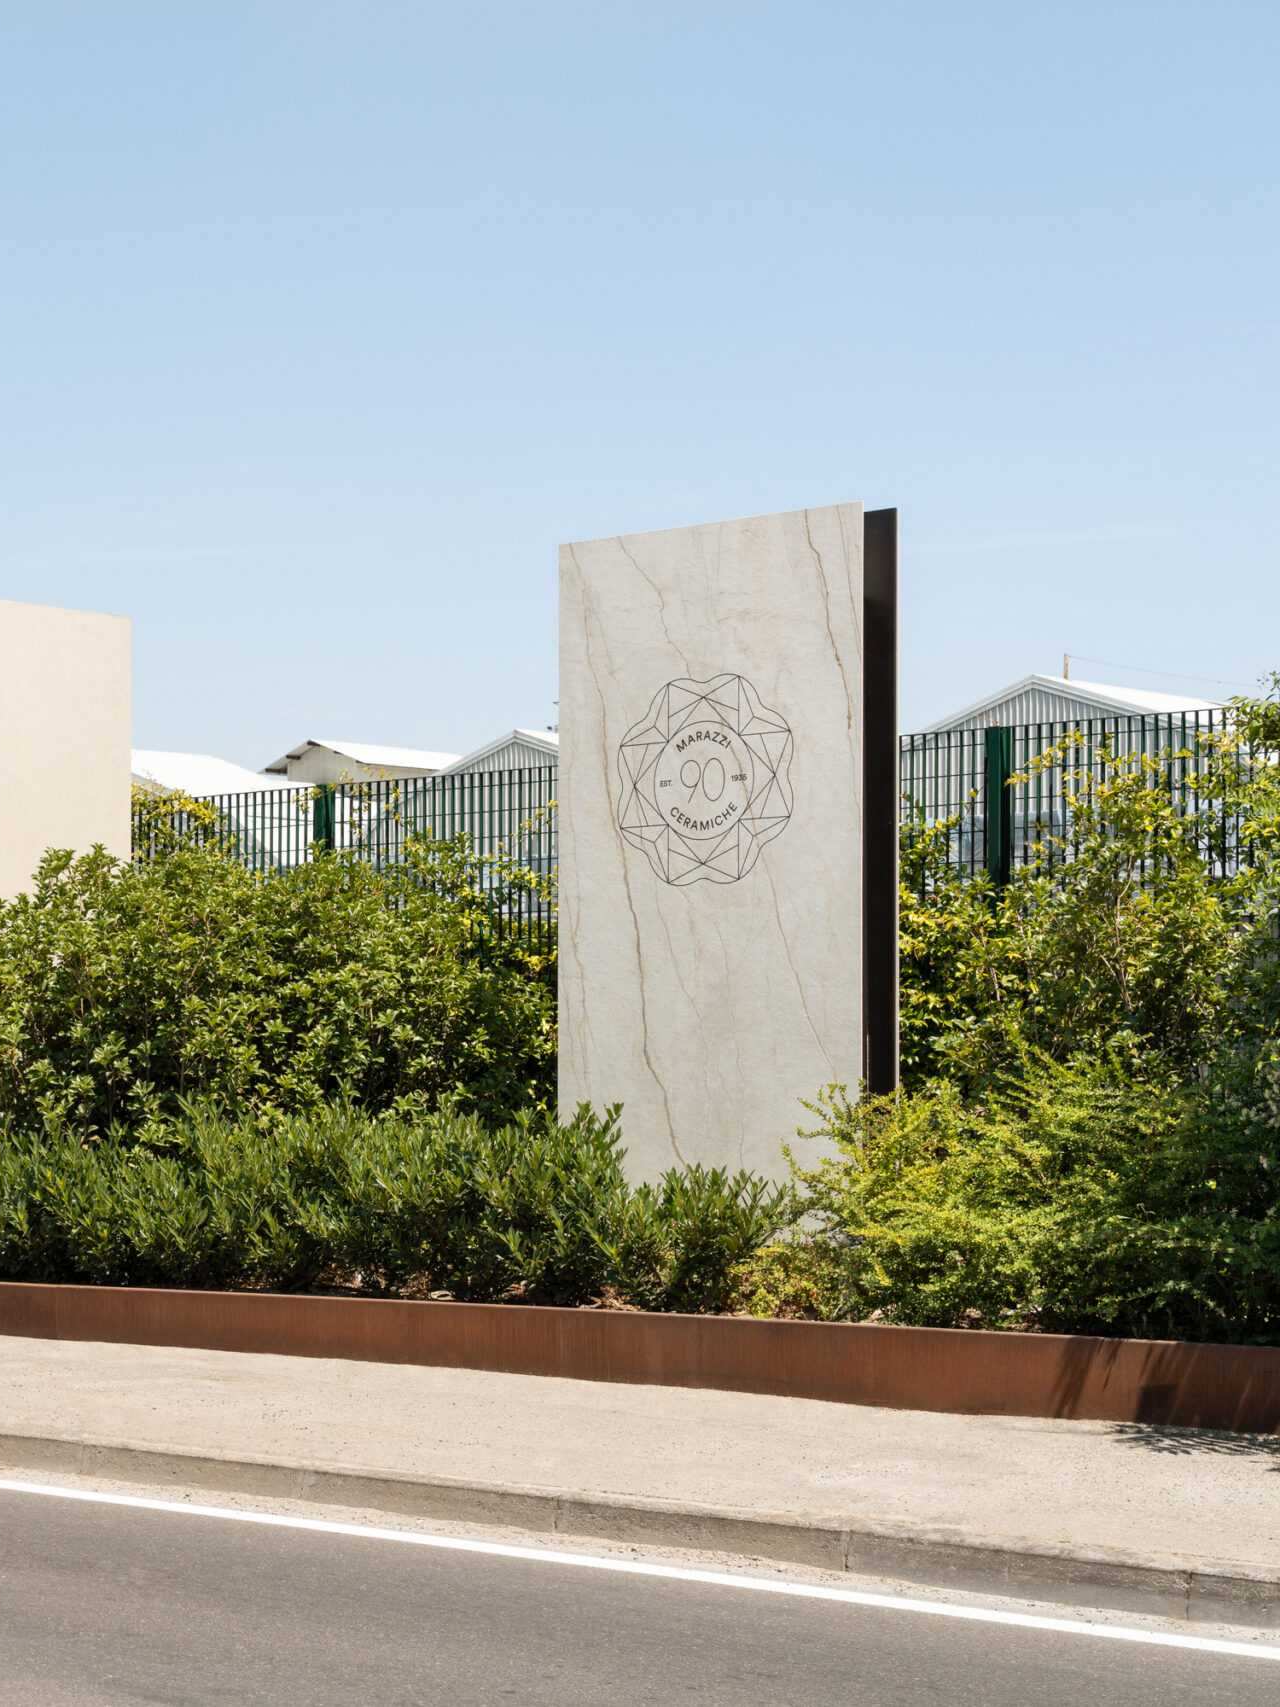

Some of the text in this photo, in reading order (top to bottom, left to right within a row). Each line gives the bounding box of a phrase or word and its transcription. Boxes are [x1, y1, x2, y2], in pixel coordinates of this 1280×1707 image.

[676, 730, 732, 752] MARAZZI
[680, 758, 725, 803] 90
[670, 801, 738, 832] CERAMICHE
